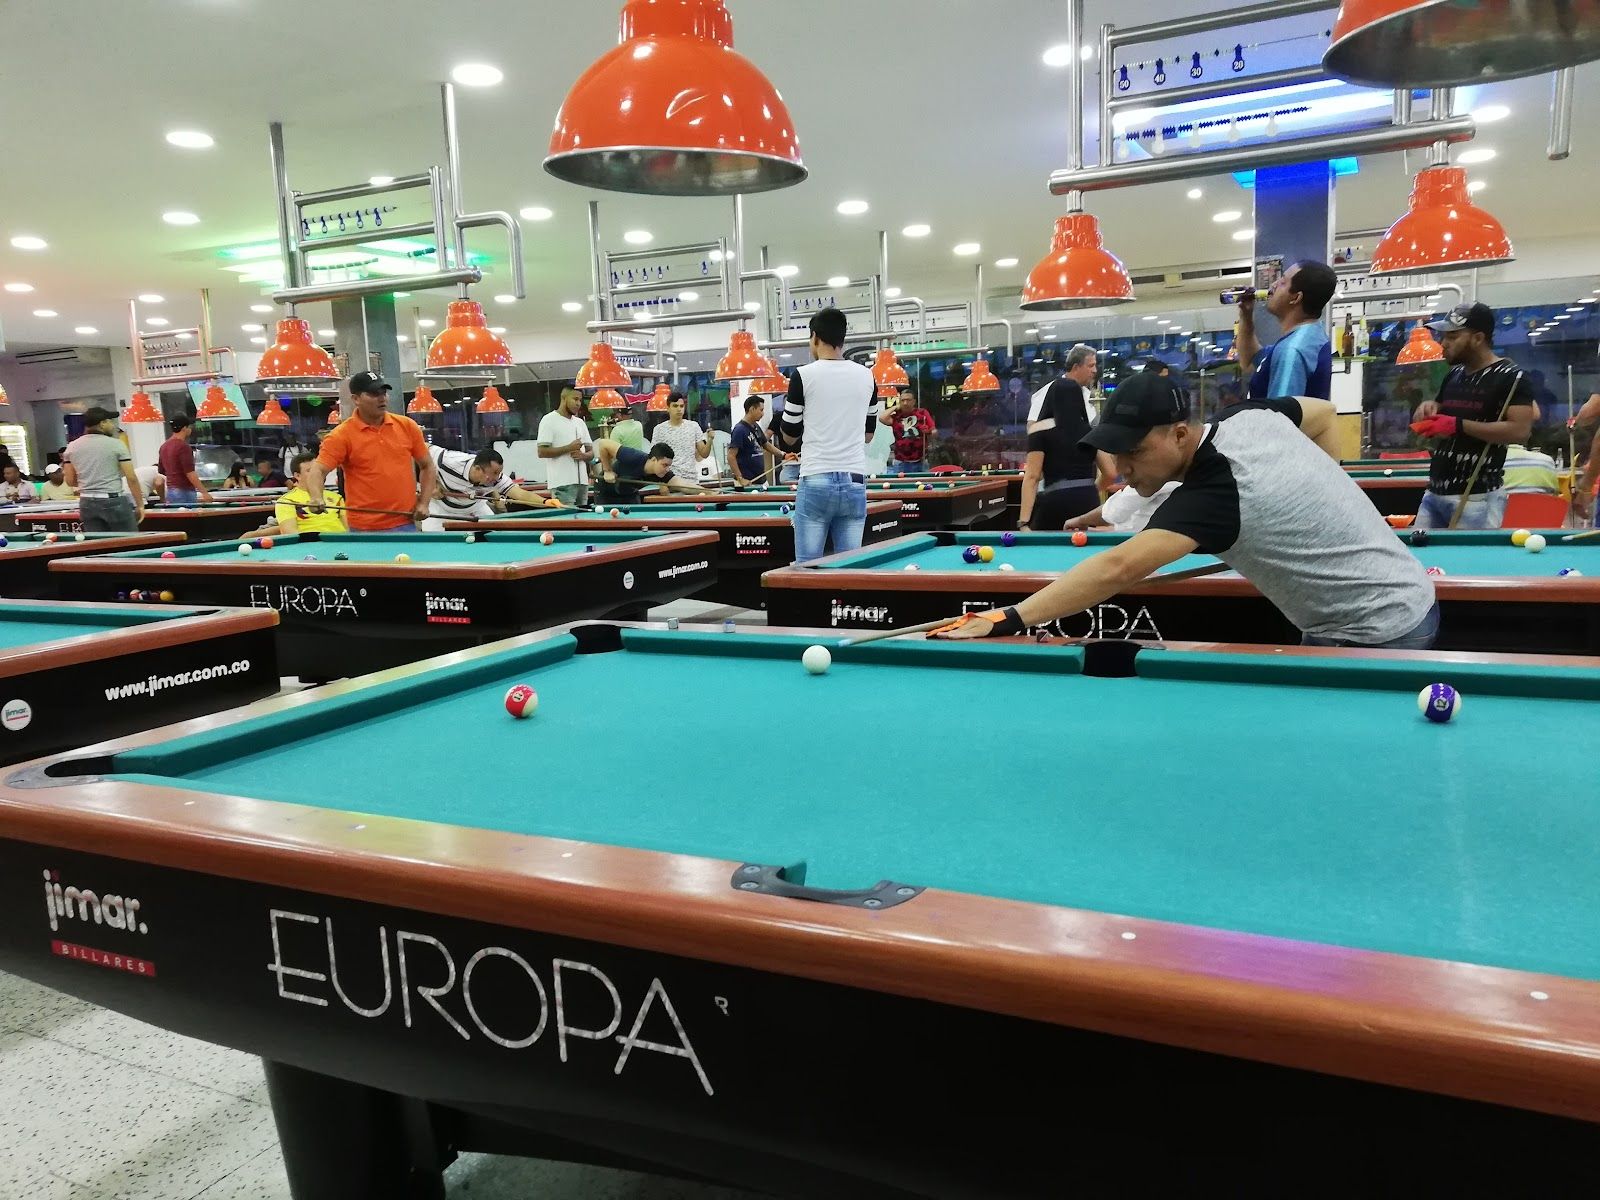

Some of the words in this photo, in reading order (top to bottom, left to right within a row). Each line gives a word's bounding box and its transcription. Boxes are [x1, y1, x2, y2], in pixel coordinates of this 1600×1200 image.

[658, 560, 709, 579] www.jimar.com.co
[250, 584, 359, 617] EUROPA
[425, 591, 469, 616] jimar.
[831, 599, 894, 627] jimar.
[105, 659, 251, 700] www.jimar.com.co
[43, 868, 149, 935] jimar.
[61, 944, 147, 974] BILLARES
[267, 908, 715, 1096] EUROPA
